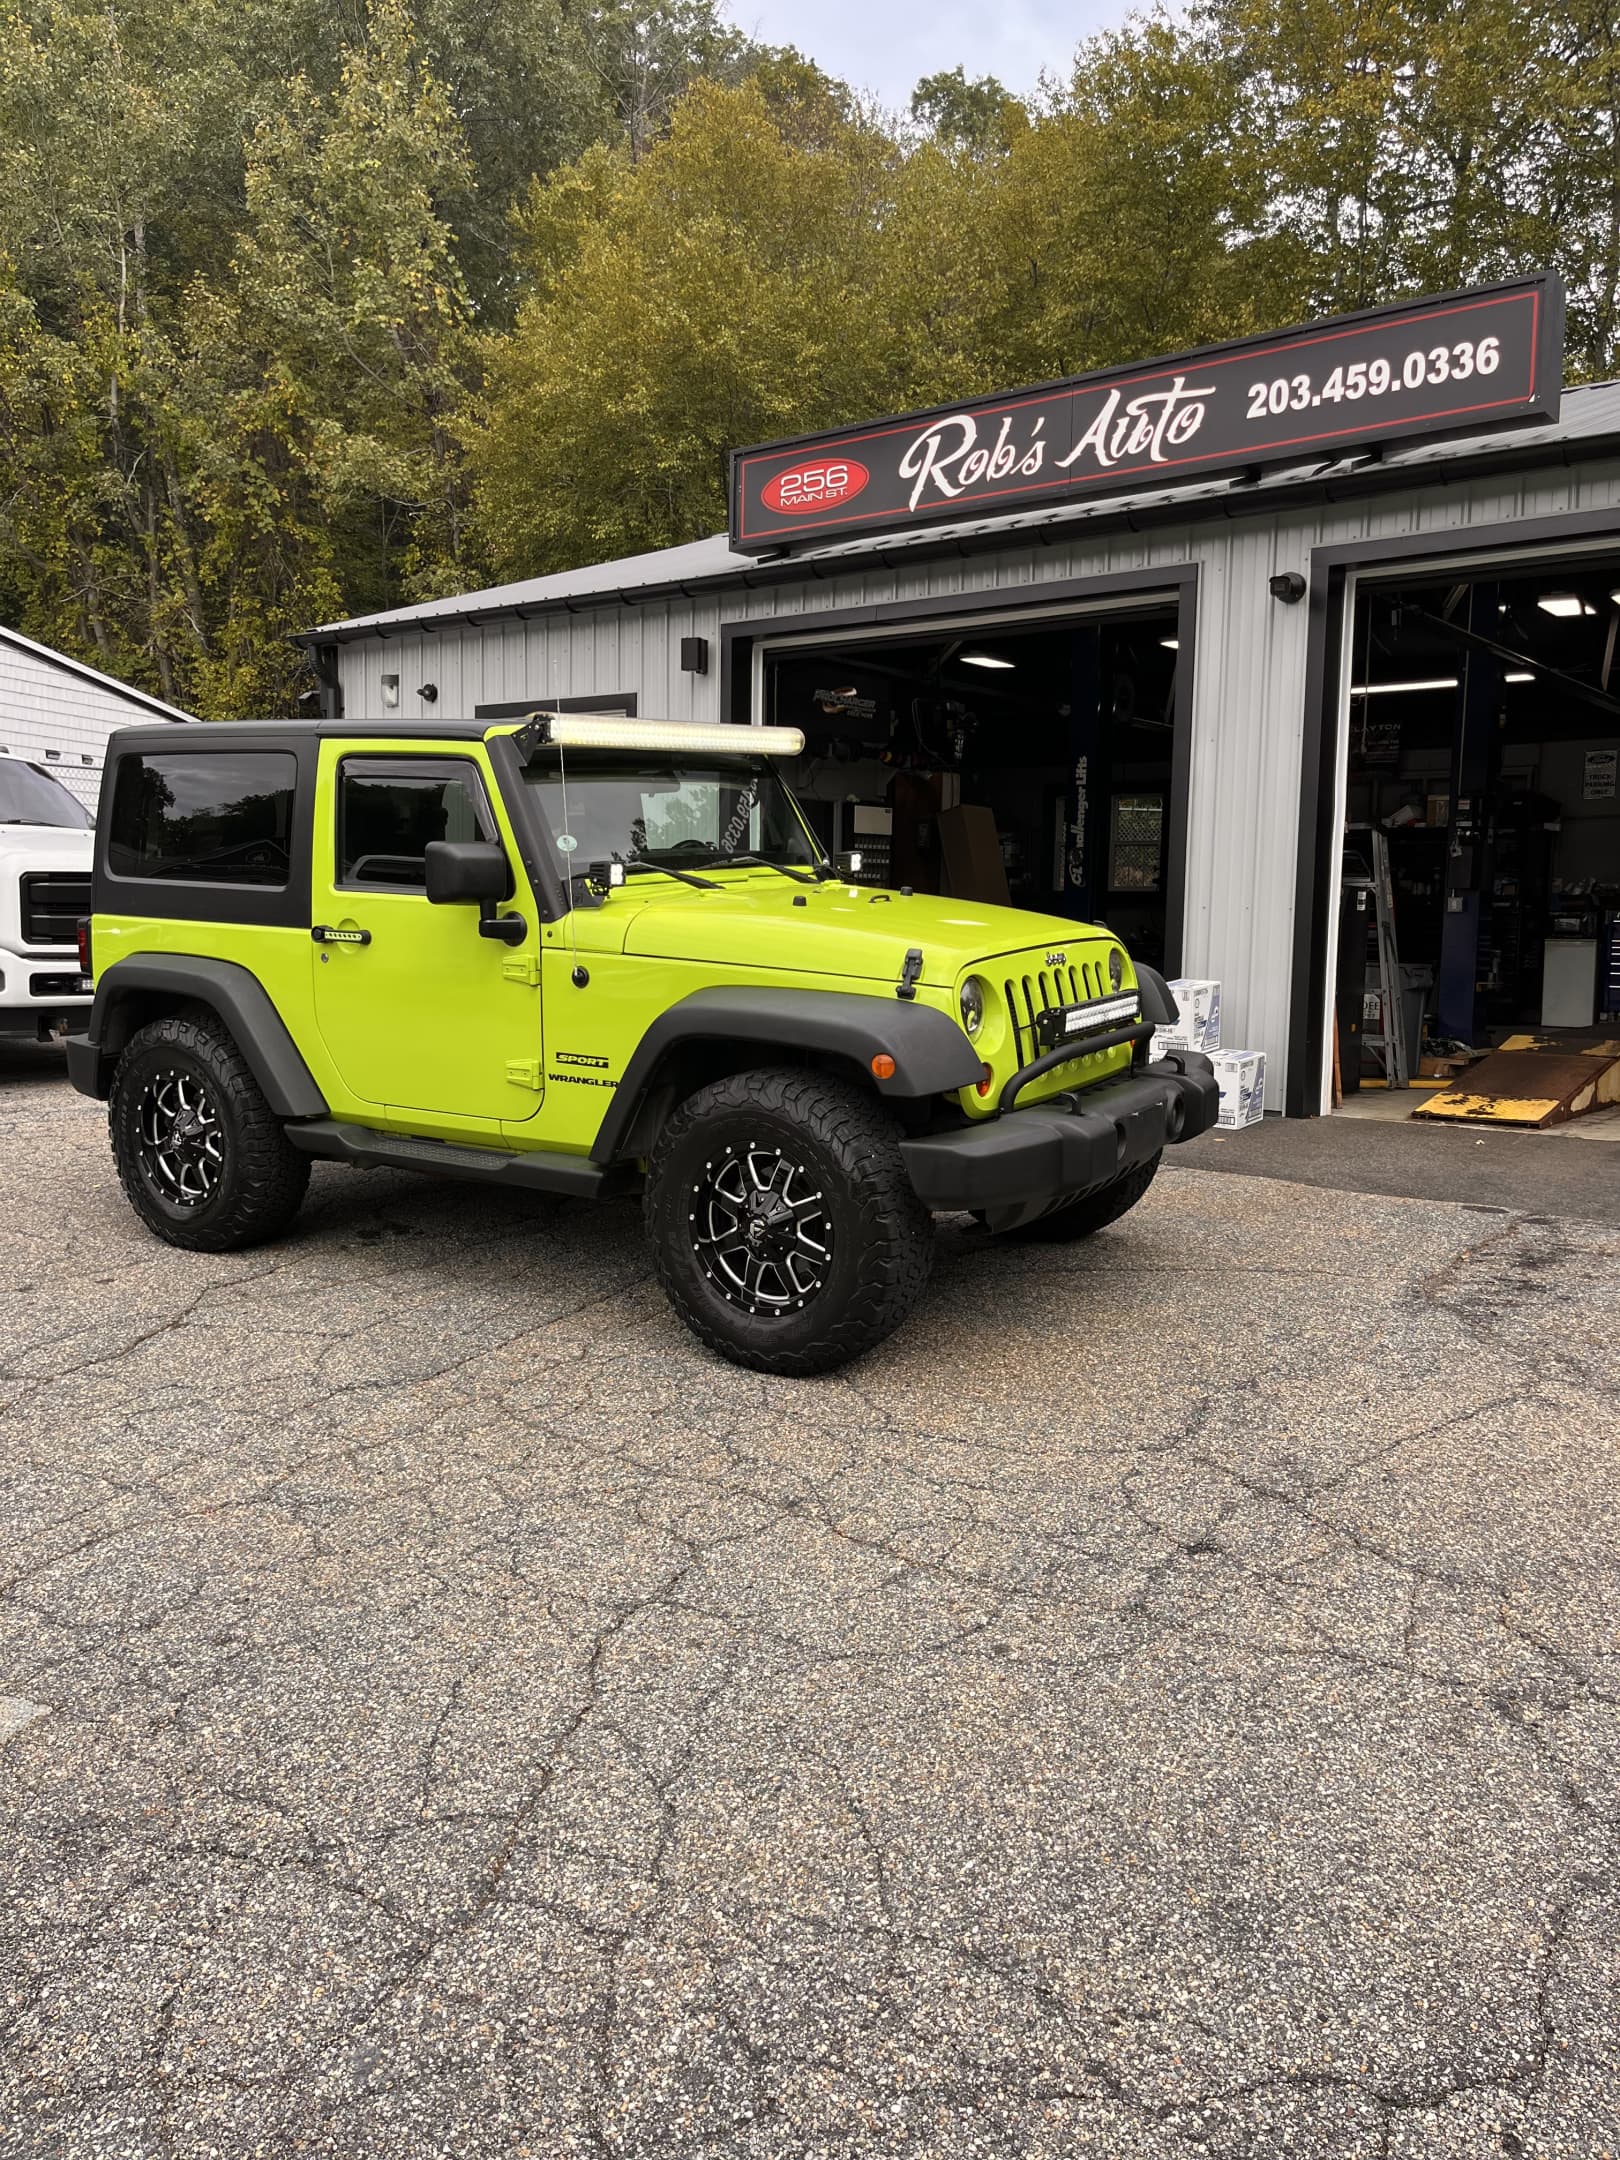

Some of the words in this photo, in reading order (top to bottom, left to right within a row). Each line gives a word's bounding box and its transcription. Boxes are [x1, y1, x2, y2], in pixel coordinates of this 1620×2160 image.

[1246, 336, 1500, 419] 203.459.0336
[898, 415, 1046, 512] Rob's
[1055, 377, 1217, 467] Auto
[780, 465, 848, 497] 256
[780, 491, 824, 507] MAIN
[825, 487, 849, 498] ST.
[1075, 755, 1088, 785] Lifts
[557, 1054, 607, 1067] SPORT
[548, 1073, 618, 1088] WRANGLER
